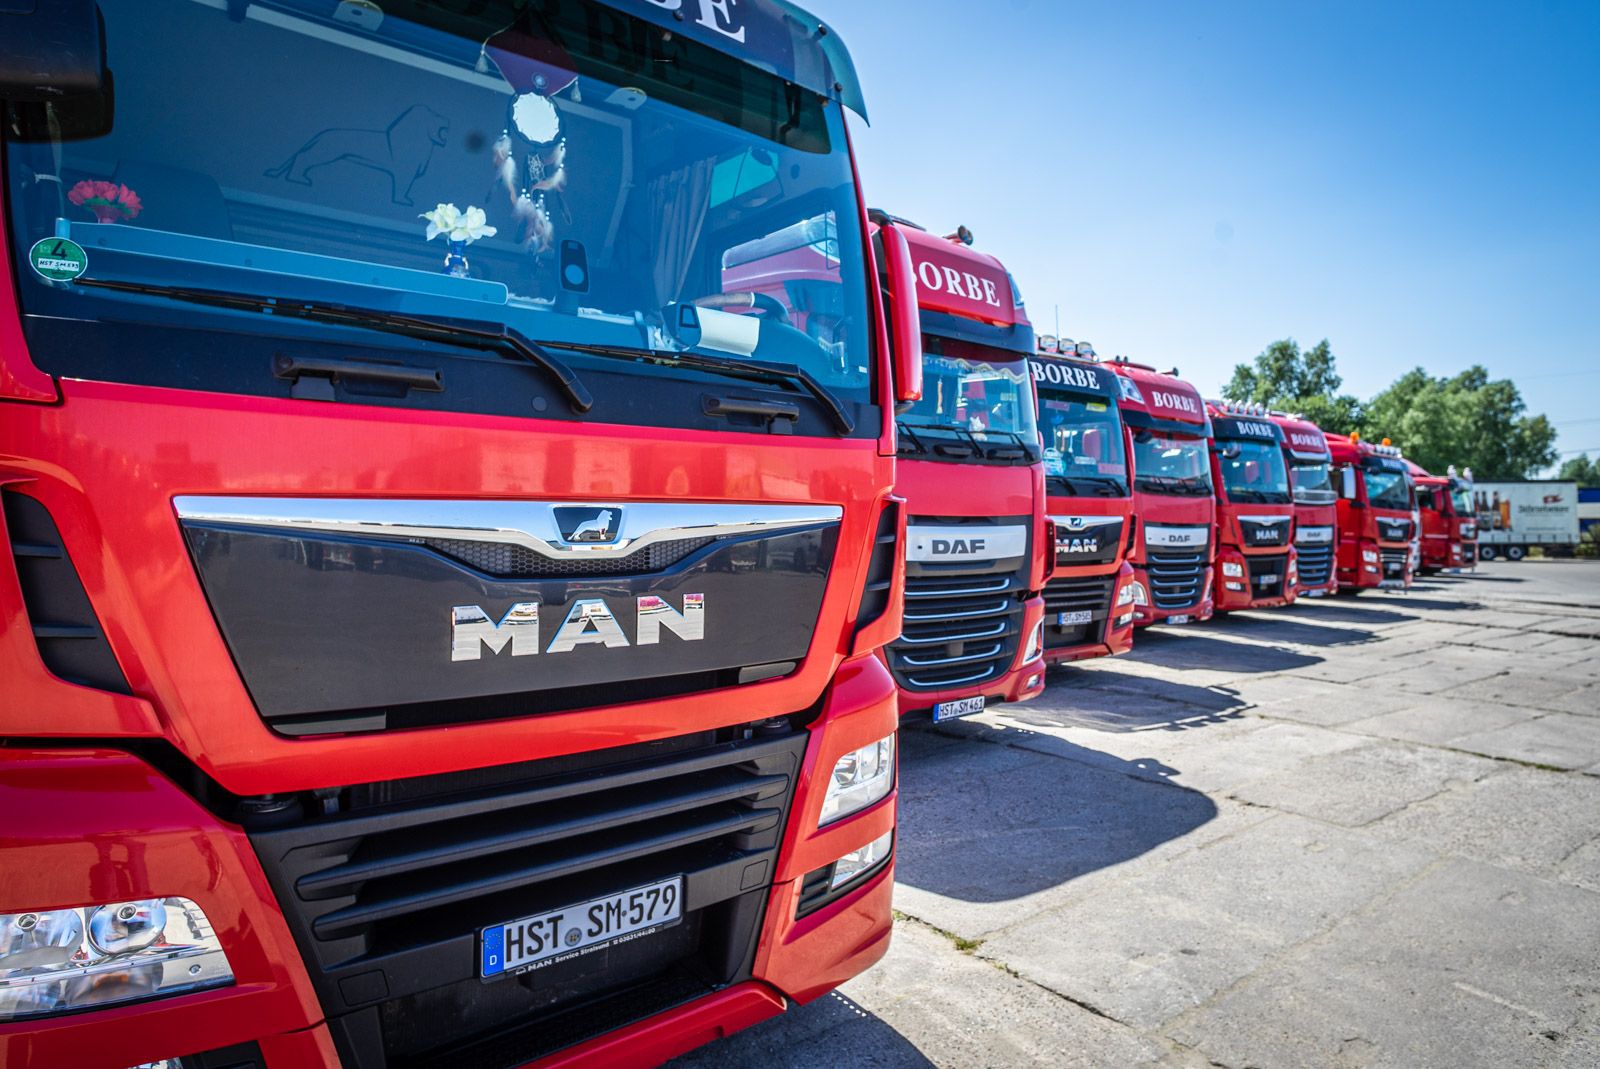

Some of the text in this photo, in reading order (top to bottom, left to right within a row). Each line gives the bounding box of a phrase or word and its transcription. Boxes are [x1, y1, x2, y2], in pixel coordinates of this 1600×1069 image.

[51, 241, 68, 260] 4
[912, 261, 1000, 307] ORBE
[1029, 361, 1100, 390] BORBE
[1151, 390, 1198, 414] BORBE
[1236, 421, 1275, 438] BORBE
[931, 539, 985, 554] DAF
[1055, 538, 1097, 553] MAN
[1168, 534, 1191, 543] DAF
[451, 592, 704, 661] MAN
[939, 703, 954, 717] HST
[489, 954, 498, 966] D
[528, 959, 552, 972] MAN
[555, 951, 579, 963] Service
[580, 941, 610, 955] Stralsund
